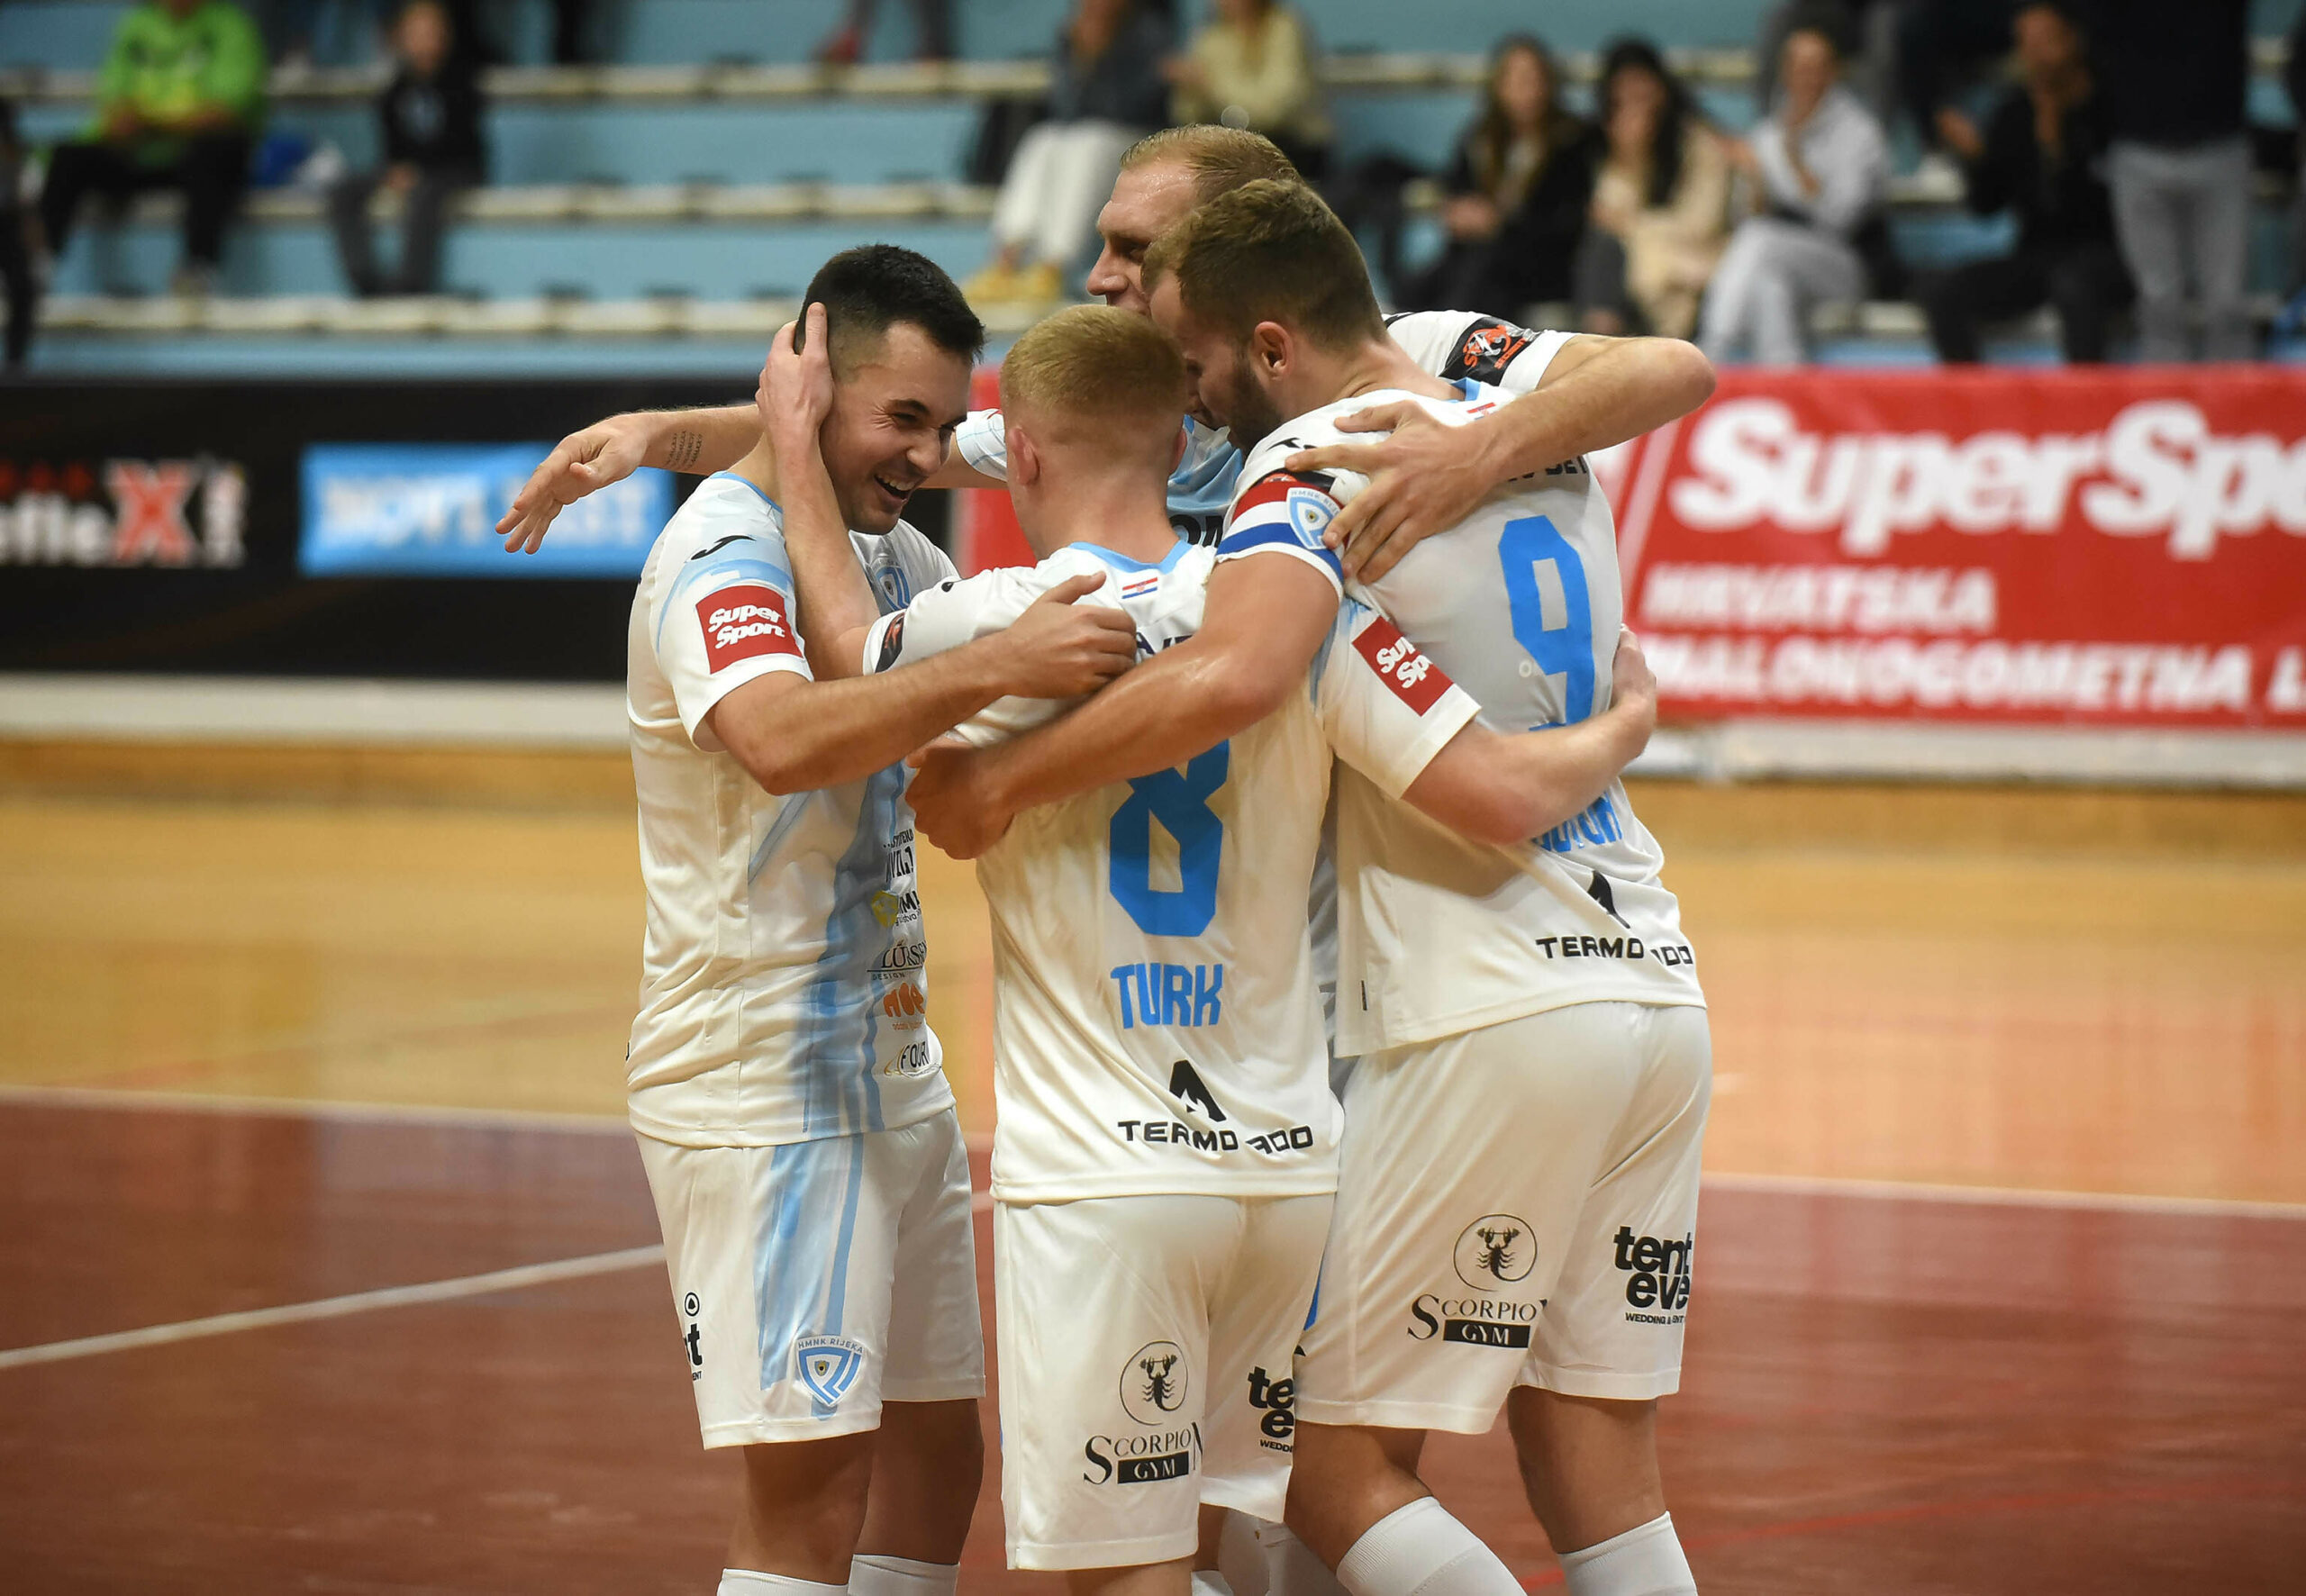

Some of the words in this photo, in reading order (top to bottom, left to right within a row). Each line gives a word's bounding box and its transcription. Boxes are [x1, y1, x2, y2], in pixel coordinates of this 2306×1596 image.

[1641, 562, 1996, 632] HRVATSKA
[708, 604, 782, 633] Super
[714, 621, 785, 649] Sport
[1499, 514, 1594, 731] 9
[1110, 739, 1230, 937] 8
[1535, 935, 1644, 959] TERMO
[1110, 962, 1223, 1029] TURK
[1117, 1120, 1239, 1151] TERMO
[1613, 1225, 1693, 1274] tent
[1406, 1293, 1548, 1340] SCORPIO
[1461, 1323, 1510, 1346] GYM
[1625, 1312, 1666, 1325] WEDDING
[798, 1338, 826, 1349] HMNK
[830, 1338, 863, 1354] RIJEKA
[1248, 1365, 1294, 1410] te
[1083, 1421, 1203, 1485] SCORPION
[1133, 1459, 1176, 1480] GYM
